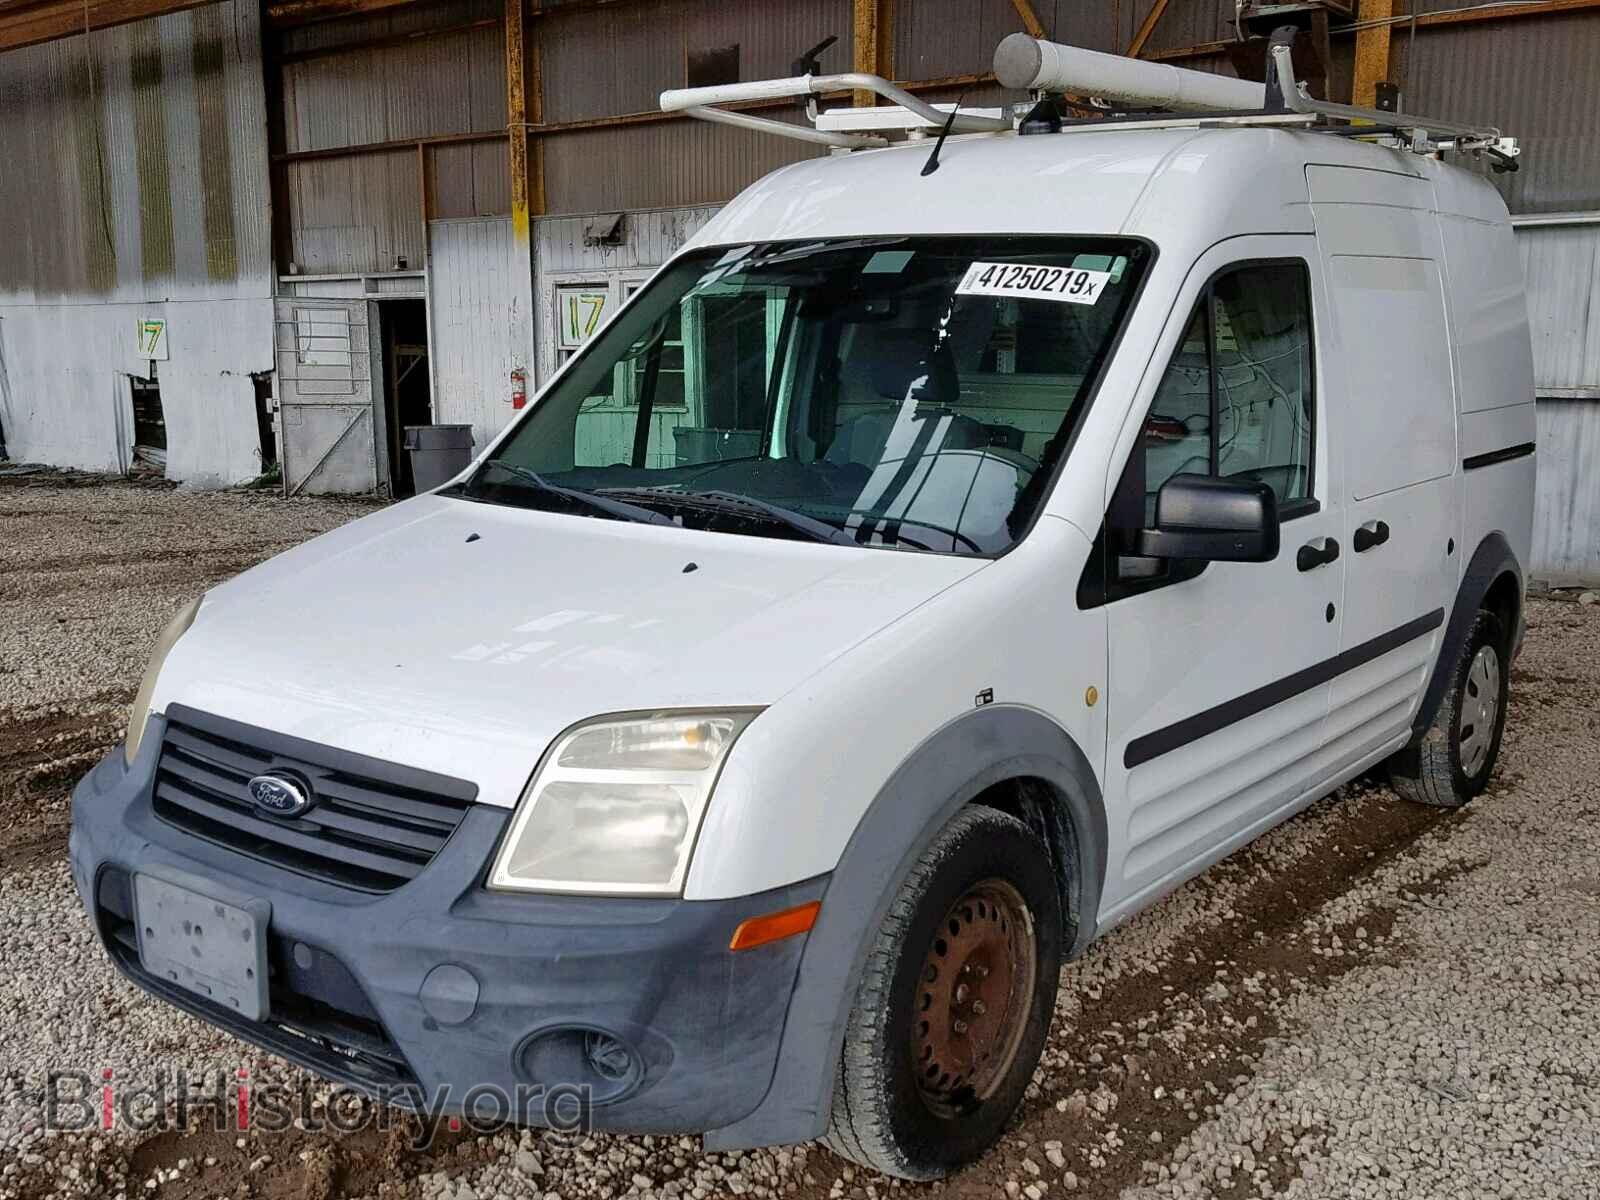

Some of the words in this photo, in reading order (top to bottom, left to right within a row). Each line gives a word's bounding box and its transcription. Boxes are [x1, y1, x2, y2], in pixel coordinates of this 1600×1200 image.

[567, 294, 606, 340] 17
[137, 320, 164, 358] 17
[256, 782, 288, 808] Ford
